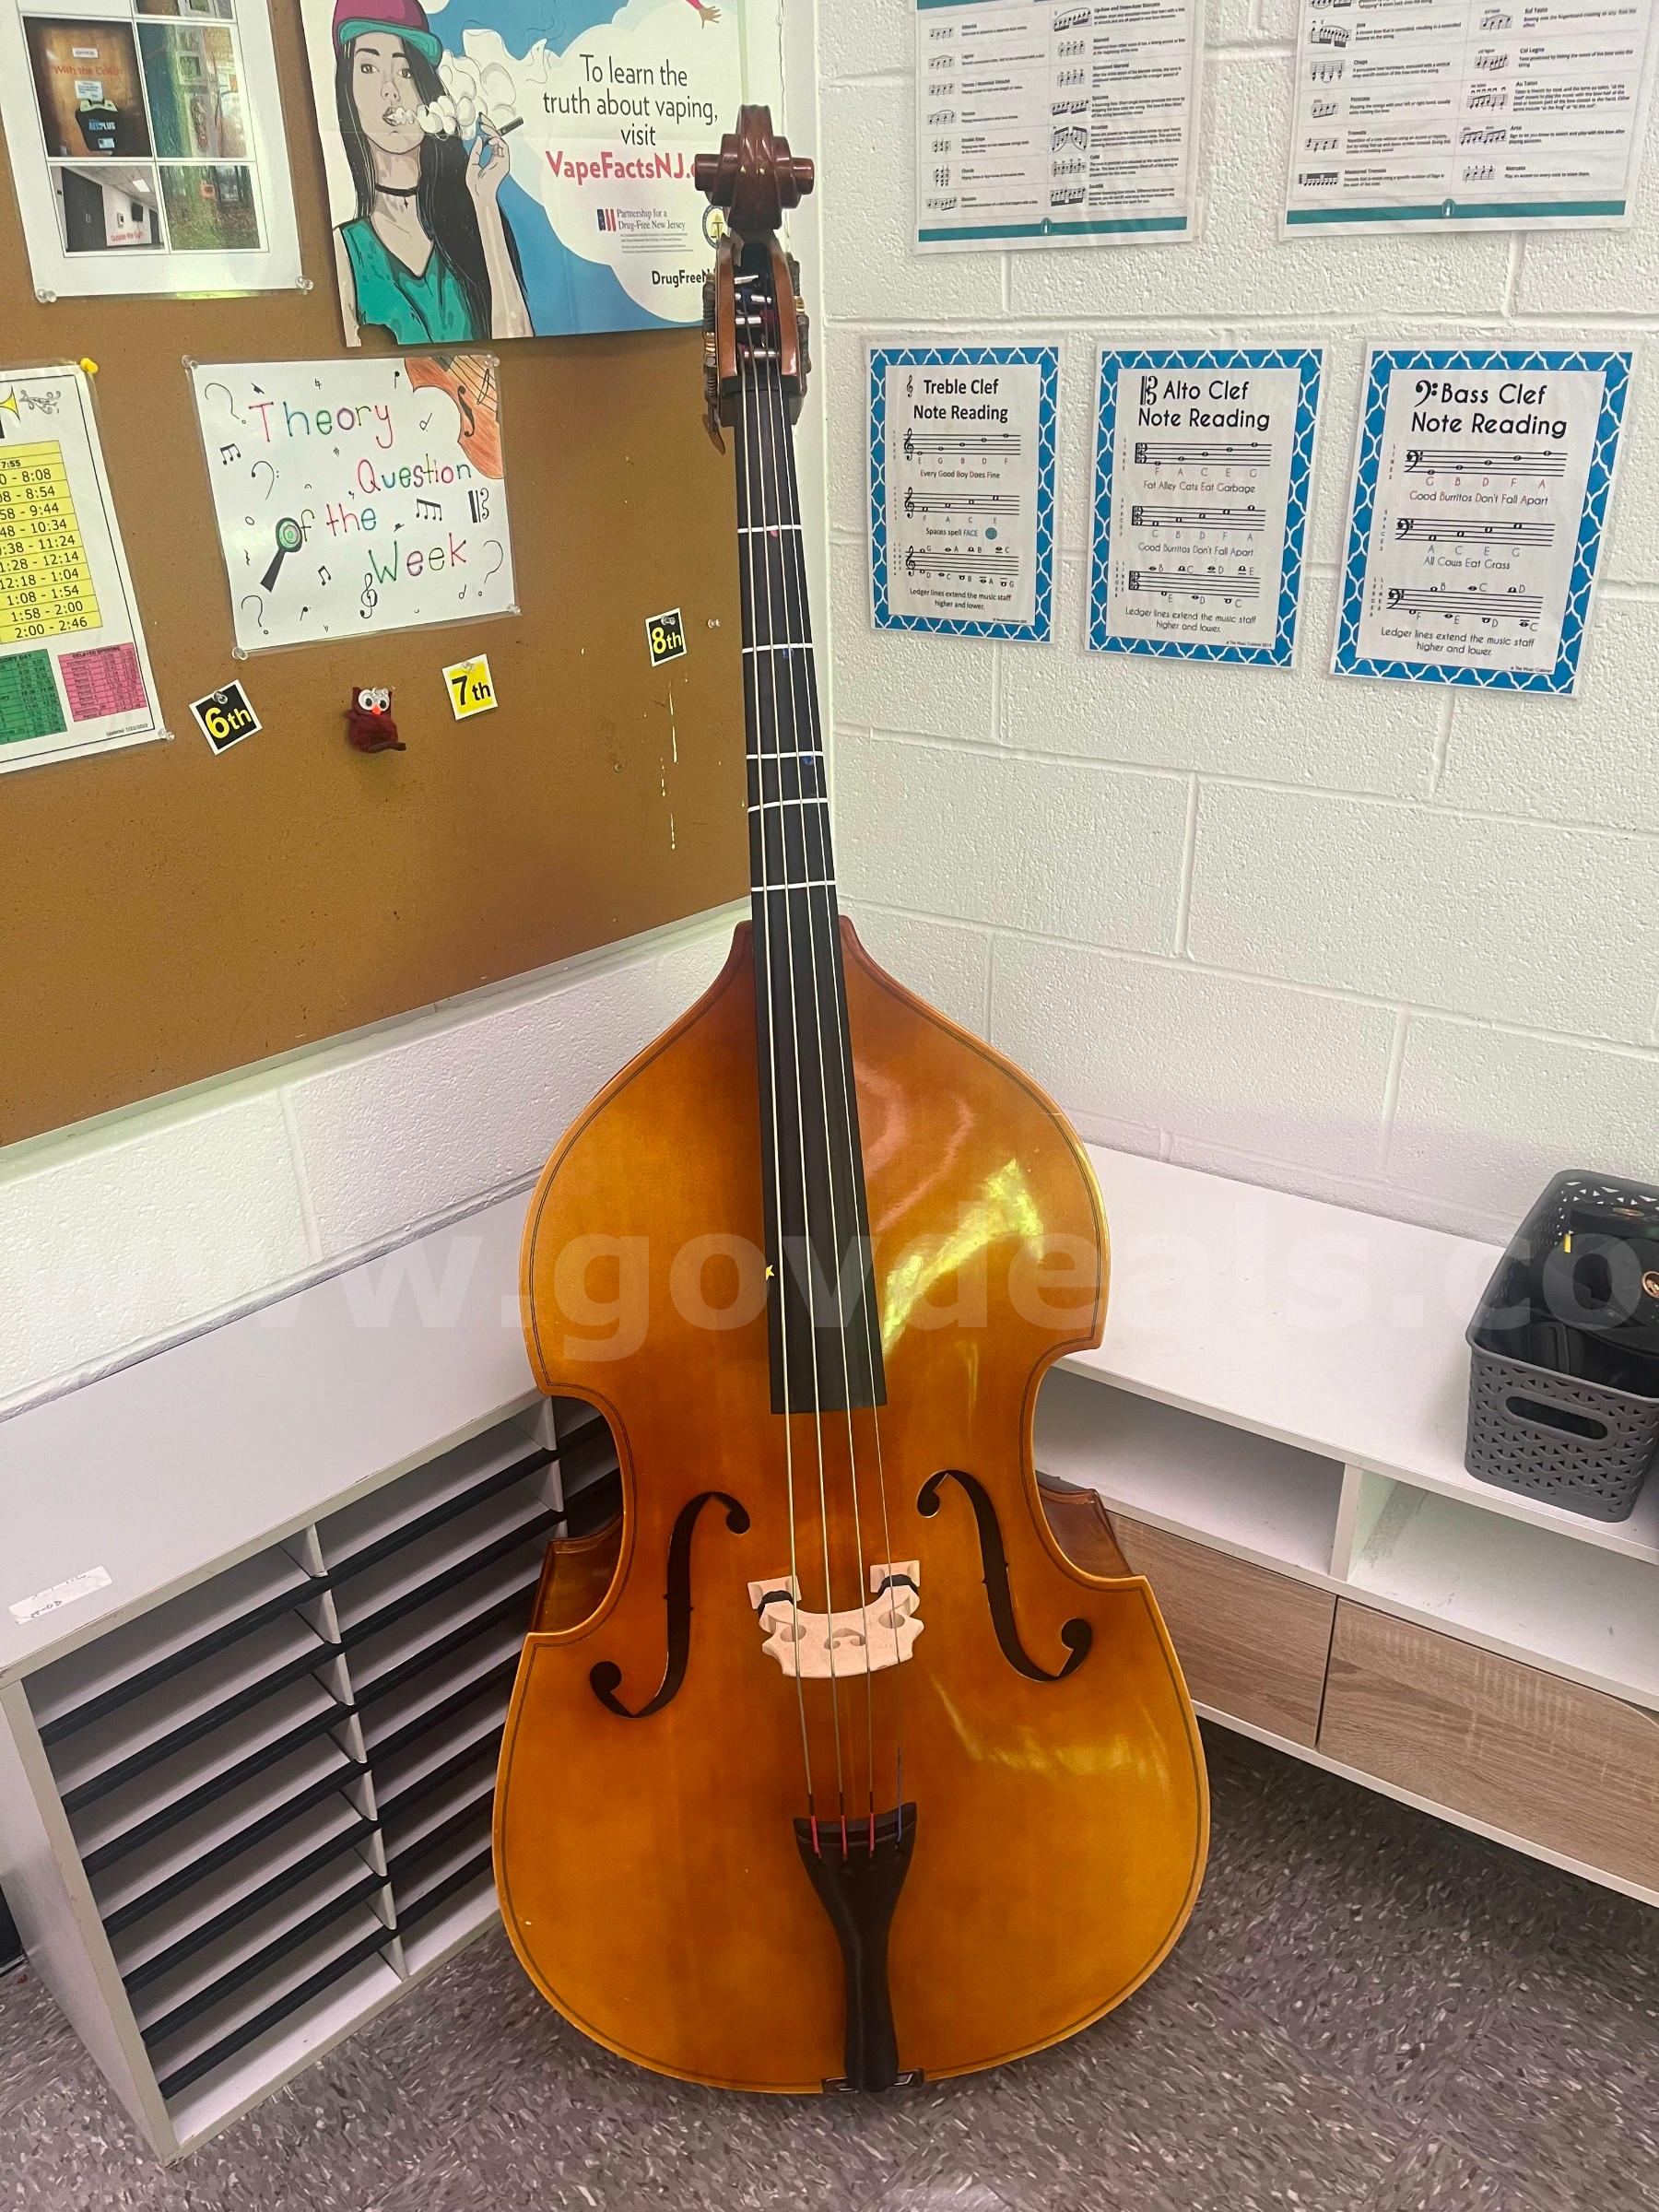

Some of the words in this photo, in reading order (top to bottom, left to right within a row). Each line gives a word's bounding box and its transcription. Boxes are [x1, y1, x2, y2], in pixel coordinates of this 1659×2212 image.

[579, 53, 603, 83] To
[608, 55, 653, 85] learn
[660, 59, 688, 87] the
[543, 86, 591, 114] truth
[596, 88, 650, 117] about
[655, 95, 718, 125] vaping,
[620, 124, 656, 147] visit
[617, 208, 652, 219] Partnership
[653, 208, 663, 218] for
[618, 220, 651, 231] Drug-Free
[652, 221, 665, 229] New
[667, 220, 686, 230] Jersey
[924, 378, 967, 394] Treble
[971, 378, 999, 394] Clef
[1163, 380, 1201, 400] Alto
[1208, 380, 1250, 400] Clef
[1441, 382, 1488, 404] Bass
[1499, 382, 1548, 405] Clef
[913, 405, 947, 419] Note
[951, 405, 1008, 424] Reading
[1138, 407, 1182, 427] Note
[1189, 407, 1270, 431] Reading
[248, 401, 394, 449] Theory
[1411, 411, 1463, 433] Note
[1471, 413, 1567, 439] Reading
[2, 459, 21, 469] 7:55
[1155, 467, 1159, 476] F
[1177, 468, 1184, 477] A
[1200, 468, 1208, 477] C
[1226, 468, 1231, 477] E
[22, 467, 52, 483] 8:08
[357, 453, 472, 494] Question
[920, 470, 937, 478] Every
[957, 470, 968, 479] Boy
[986, 471, 1000, 479] Fine
[1143, 480, 1157, 489] Fat
[1159, 480, 1176, 492] Alley
[1179, 481, 1198, 491] Cats
[1200, 482, 1215, 492] Eat
[1454, 477, 1461, 487] B
[1482, 477, 1488, 488] D
[1511, 478, 1517, 488] F
[1538, 479, 1546, 488] A
[26, 485, 55, 500] 8:54
[1439, 491, 1472, 502] Burritos
[1475, 492, 1498, 503] Don't
[1500, 493, 1518, 504] Fall
[1520, 494, 1548, 506] Apart
[29, 501, 60, 517] 9:44
[30, 518, 67, 535] 10:34
[326, 503, 376, 536] the
[925, 527, 947, 535] Spaces
[947, 528, 962, 537] spell
[1175, 531, 1181, 539] B
[1199, 531, 1205, 540] D
[1222, 531, 1228, 539] F
[1247, 534, 1253, 542] A
[39, 535, 76, 550] 11:24
[1428, 545, 1434, 554] A
[1454, 546, 1463, 555] C
[1484, 547, 1490, 556] E
[43, 550, 79, 567] 12:14
[368, 532, 467, 584] Week
[1214, 546, 1229, 556] Fall
[1230, 547, 1253, 558] Apart
[1423, 557, 1434, 566] All
[1465, 558, 1481, 569] Eat
[51, 568, 79, 582] 1:04
[6, 591, 37, 606] 1:08
[51, 584, 80, 599] 1:54
[910, 588, 930, 597] Ledger
[930, 589, 945, 597] lines
[945, 590, 966, 599] extend
[967, 591, 978, 599] the
[978, 593, 996, 601] music
[997, 594, 1011, 602] staff
[11, 607, 41, 623] 1:58
[54, 600, 84, 616] 2:00
[935, 600, 953, 609] higher
[966, 602, 984, 610] lower.
[1125, 606, 1151, 618] Ledger
[1153, 608, 1171, 618] lines
[1171, 610, 1198, 620] extend
[1201, 612, 1213, 621] the
[1216, 613, 1236, 623] music
[1239, 615, 1257, 624] staff
[14, 623, 45, 639] 2:00
[58, 616, 88, 631] 2:46
[1156, 620, 1180, 630] higher
[1182, 622, 1197, 631] and
[652, 627, 682, 654] 8th
[1381, 627, 1412, 639] Ledger
[1415, 629, 1433, 640] lines
[1435, 629, 1467, 642] extend
[1470, 632, 1484, 643] the
[1487, 635, 1511, 646] music
[1513, 636, 1535, 648] staff
[1417, 641, 1443, 653] higher
[1446, 643, 1465, 653] and
[452, 675, 491, 706] 7th
[206, 707, 253, 739] 6th
